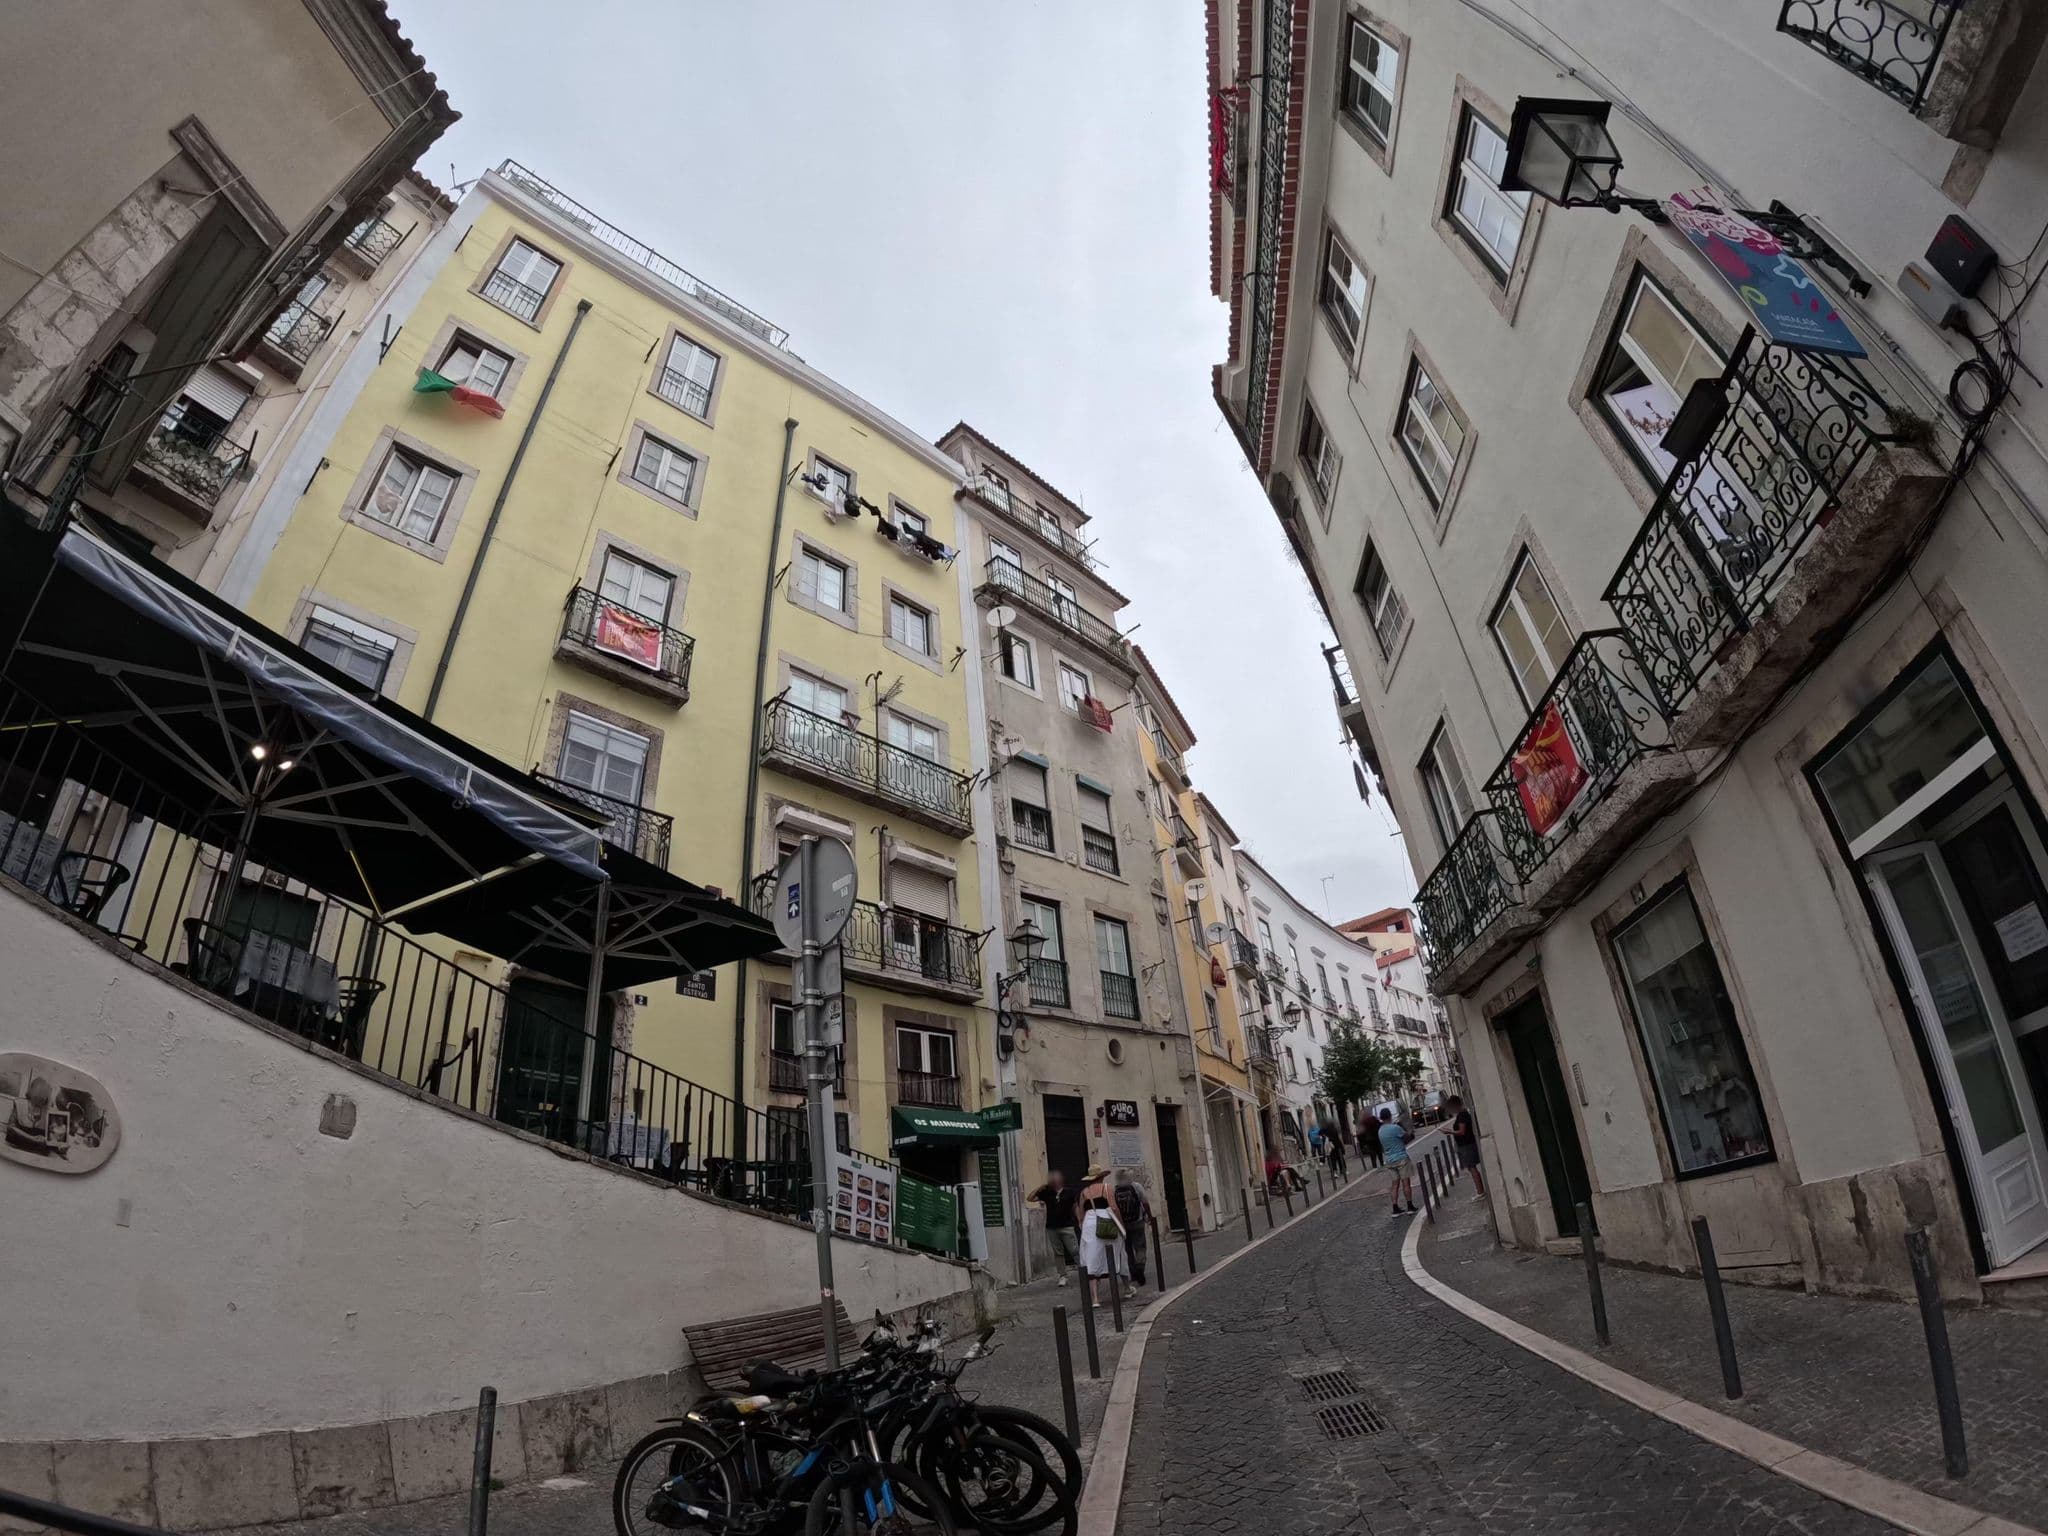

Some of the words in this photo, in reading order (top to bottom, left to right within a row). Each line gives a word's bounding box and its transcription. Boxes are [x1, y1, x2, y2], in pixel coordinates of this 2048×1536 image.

[687, 981, 706, 991] SANTO
[1111, 1103, 1134, 1115] PURO
[914, 1118, 927, 1126] OS
[930, 1120, 980, 1129] MINHOTOS
